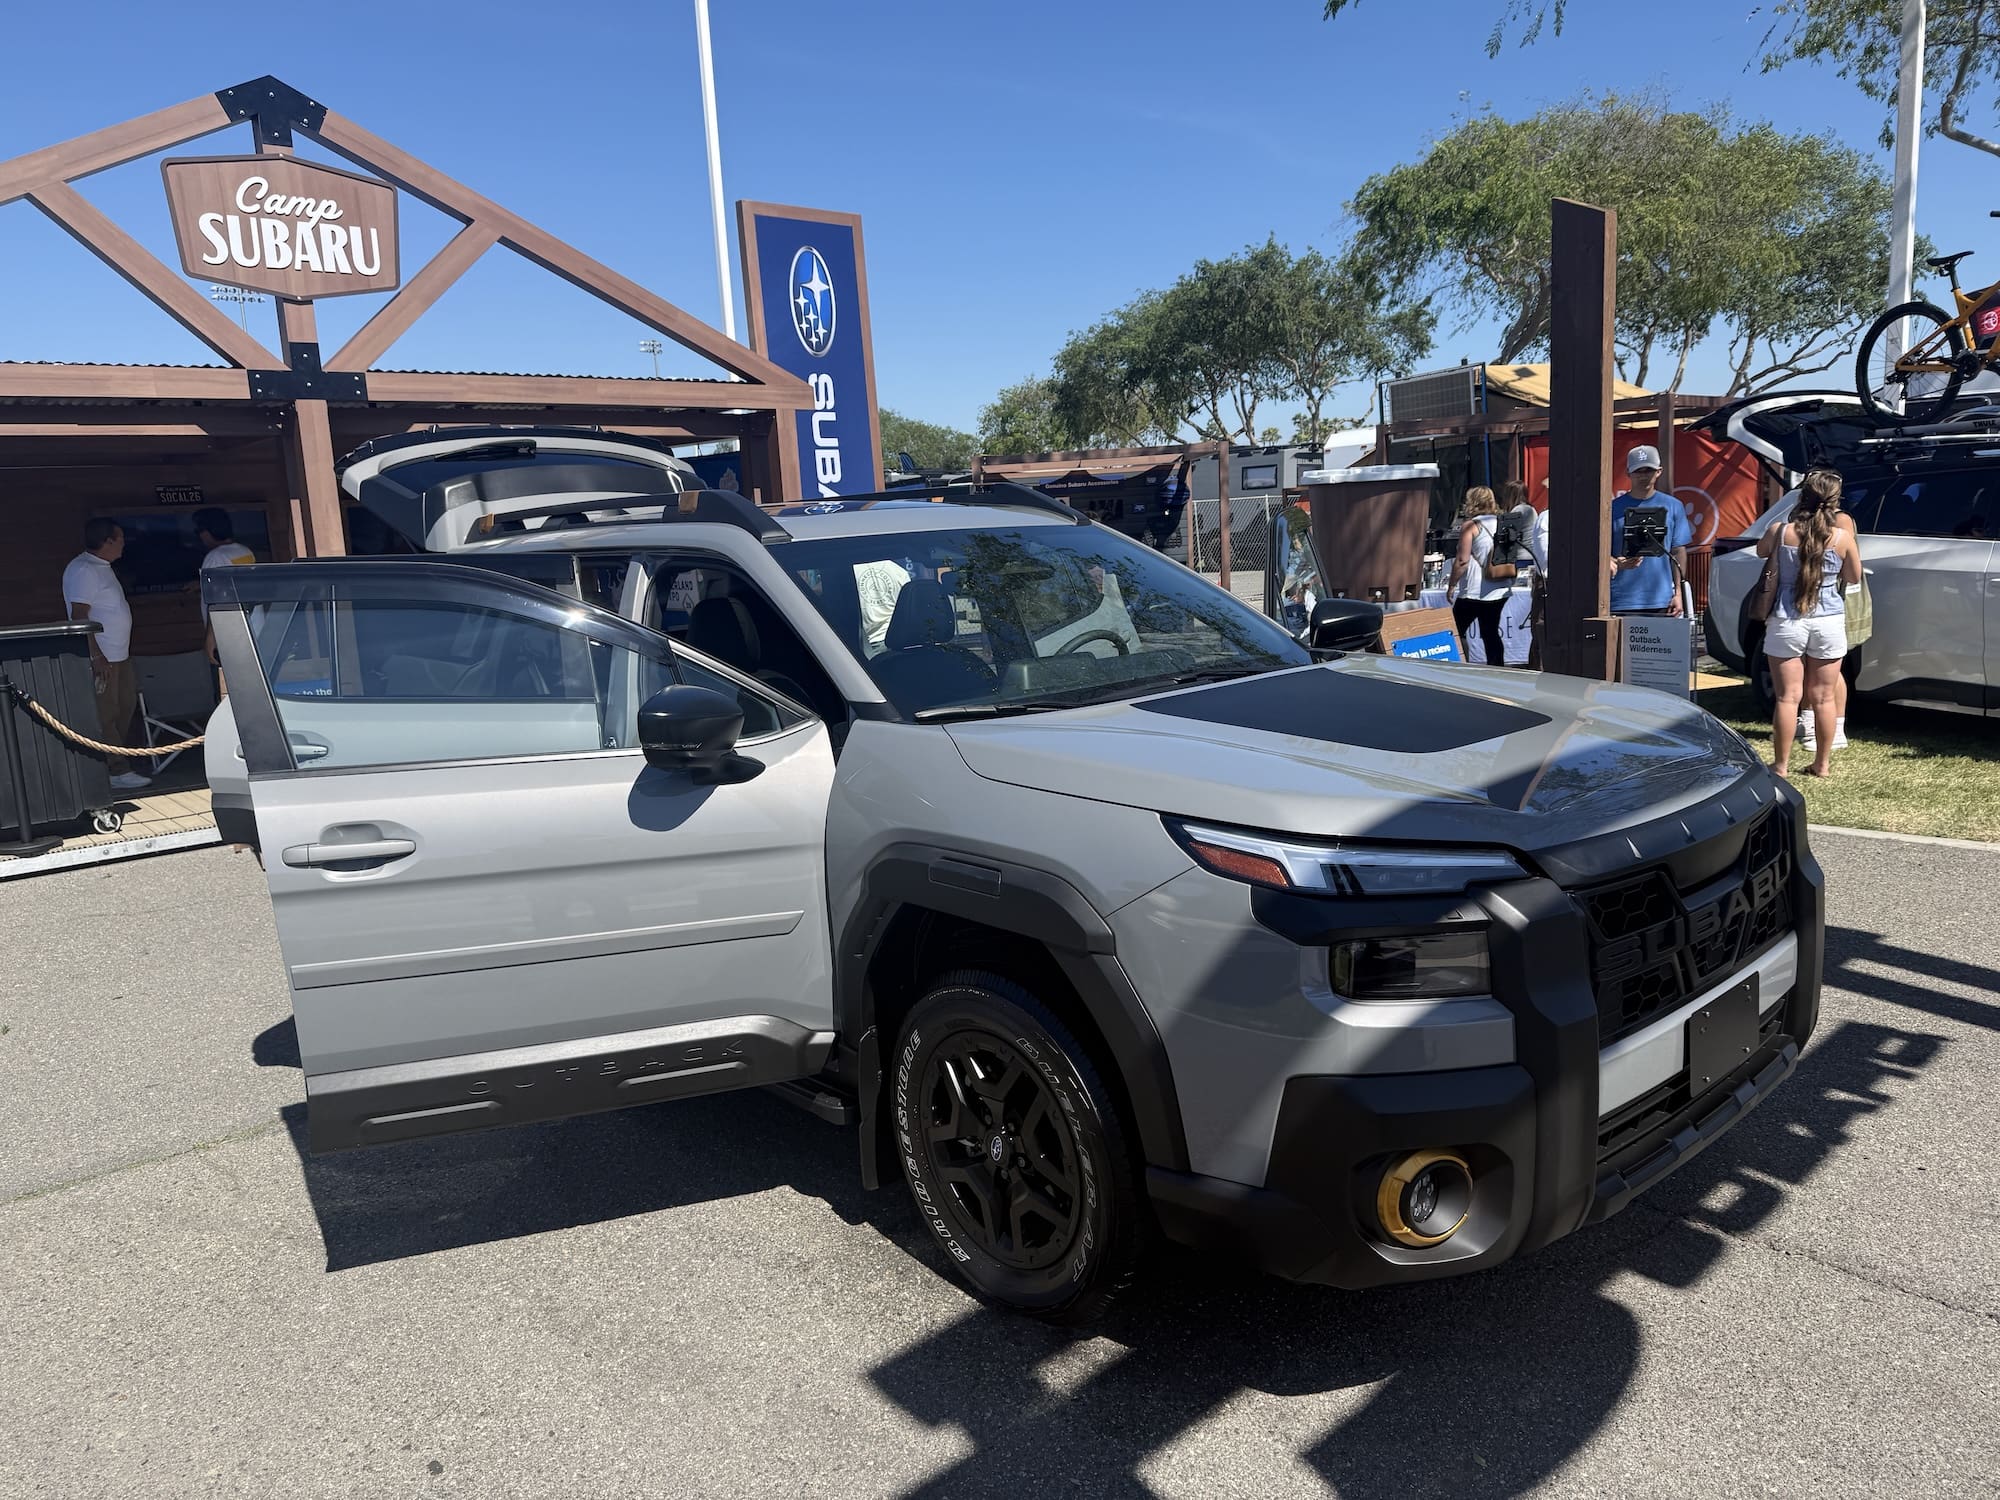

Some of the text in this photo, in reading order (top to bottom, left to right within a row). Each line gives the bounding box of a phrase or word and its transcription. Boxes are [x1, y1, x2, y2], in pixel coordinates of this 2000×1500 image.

[236, 176, 344, 230] Camp
[198, 212, 382, 276] SUBARU
[160, 491, 201, 503] SOCAL26
[1068, 480, 1087, 488] Subaru
[1088, 479, 1119, 487] Accessories
[1629, 626, 1649, 634] 2026
[1629, 635, 1662, 644] Outback
[1420, 648, 1428, 657] to
[1629, 644, 1673, 654] Wilderness
[1596, 850, 1792, 981] SUBARU
[468, 1039, 744, 1095] OUTBACK
[1016, 1037, 1097, 1209] DUELER
[896, 1028, 971, 1263] BRIDGESTONE
